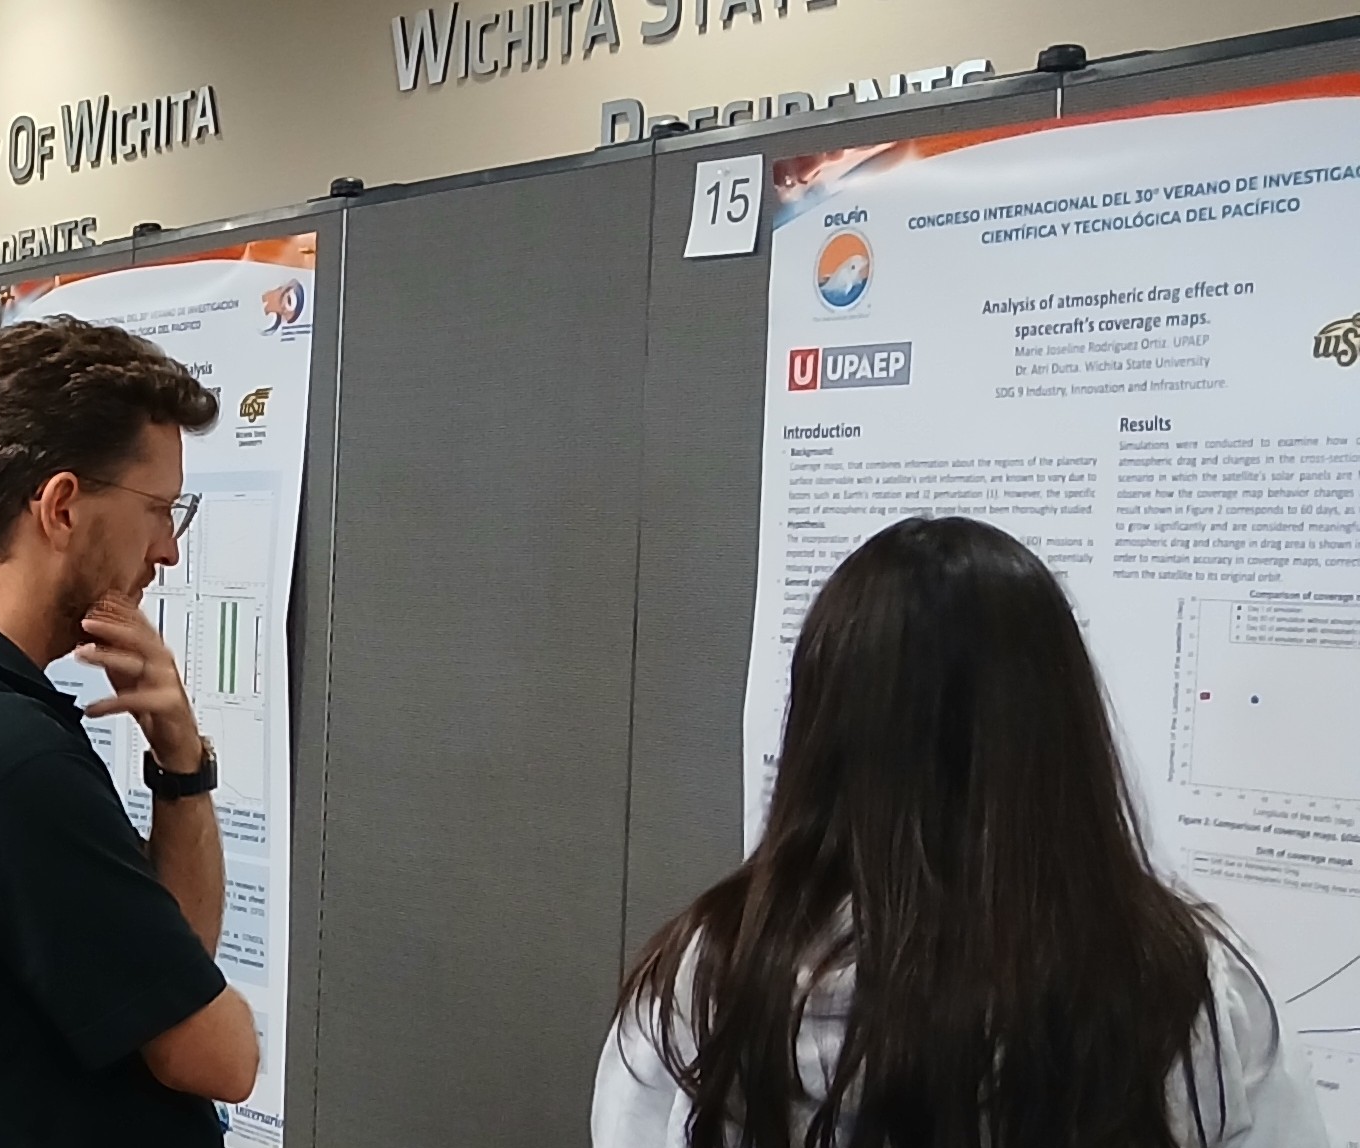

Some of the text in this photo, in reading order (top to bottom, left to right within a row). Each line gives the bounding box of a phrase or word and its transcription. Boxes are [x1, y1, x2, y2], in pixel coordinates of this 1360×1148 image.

[392, 0, 619, 91] WICHITA
[9, 116, 55, 184] OF
[61, 85, 220, 172] WICHITA
[706, 178, 750, 225] 15
[908, 209, 980, 230] CONGRESO
[983, 194, 1098, 222] INTERNACIONAL
[1102, 191, 1131, 208] DEL
[1162, 179, 1230, 200] VERANO
[1235, 175, 1258, 193] DE
[981, 196, 1300, 245] CIENTÍFICA Y TECNOLÓGICA DEL PACÍFICO
[982, 280, 1253, 316] Analysis of atmospheric drag effect on
[1014, 312, 1212, 341] spacecraft's coverage maps.
[1172, 333, 1209, 349] UPAEP
[794, 350, 905, 386] U UPAEP
[1084, 359, 1122, 373] Wichita
[1126, 357, 1152, 371] State
[1155, 354, 1210, 369] University
[994, 385, 1014, 399] SDG
[1070, 379, 1124, 395] Innovation
[1127, 378, 1147, 393] and
[783, 423, 861, 440] Introduction
[1119, 415, 1172, 433] Results
[1119, 437, 1169, 451] Simulations
[1204, 435, 1253, 450] conducted
[1277, 434, 1318, 450] examine
[1326, 434, 1347, 449] how
[1176, 454, 1196, 469] drag
[1200, 453, 1218, 466] and
[1222, 453, 1260, 468] changes
[1278, 452, 1295, 467] the
[1299, 451, 1360, 467] cross-sectio
[1201, 470, 1217, 482] the
[1267, 486, 1310, 499] behavior
[1313, 486, 1354, 501] changes
